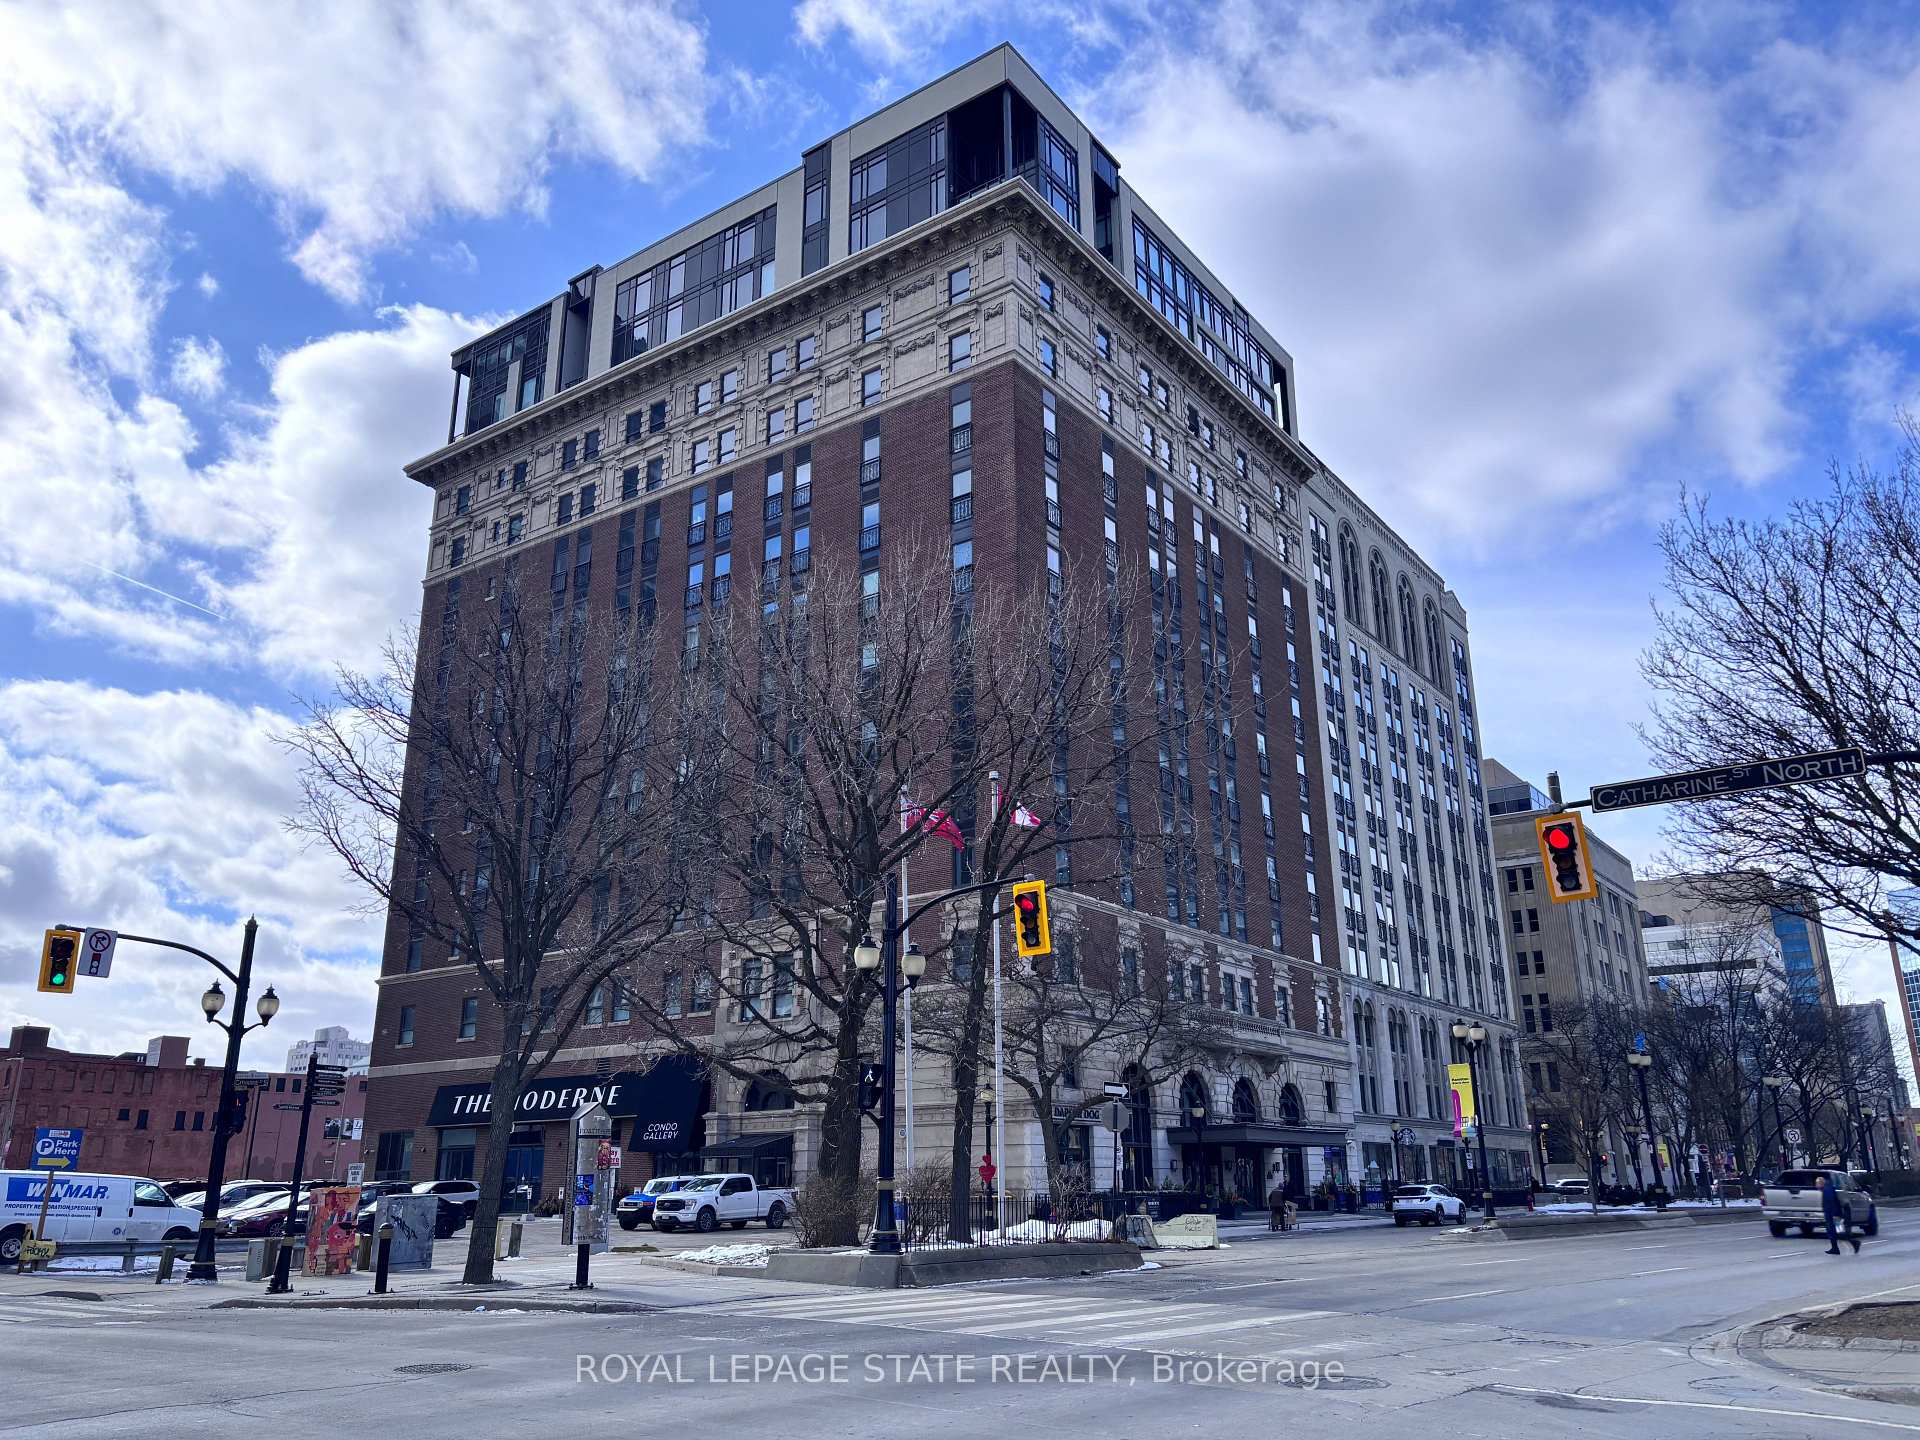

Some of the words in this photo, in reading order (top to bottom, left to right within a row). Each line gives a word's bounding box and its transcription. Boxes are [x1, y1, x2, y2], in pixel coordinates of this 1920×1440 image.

[1597, 774, 1729, 807] CATHARINE
[1762, 755, 1857, 783] NORTH
[453, 1095, 492, 1114] THE
[514, 1085, 622, 1112] ODERNE
[648, 1122, 678, 1132] CONDO
[643, 1131, 679, 1140] GALLERY
[55, 1139, 79, 1148] Park
[54, 1147, 77, 1156] Here
